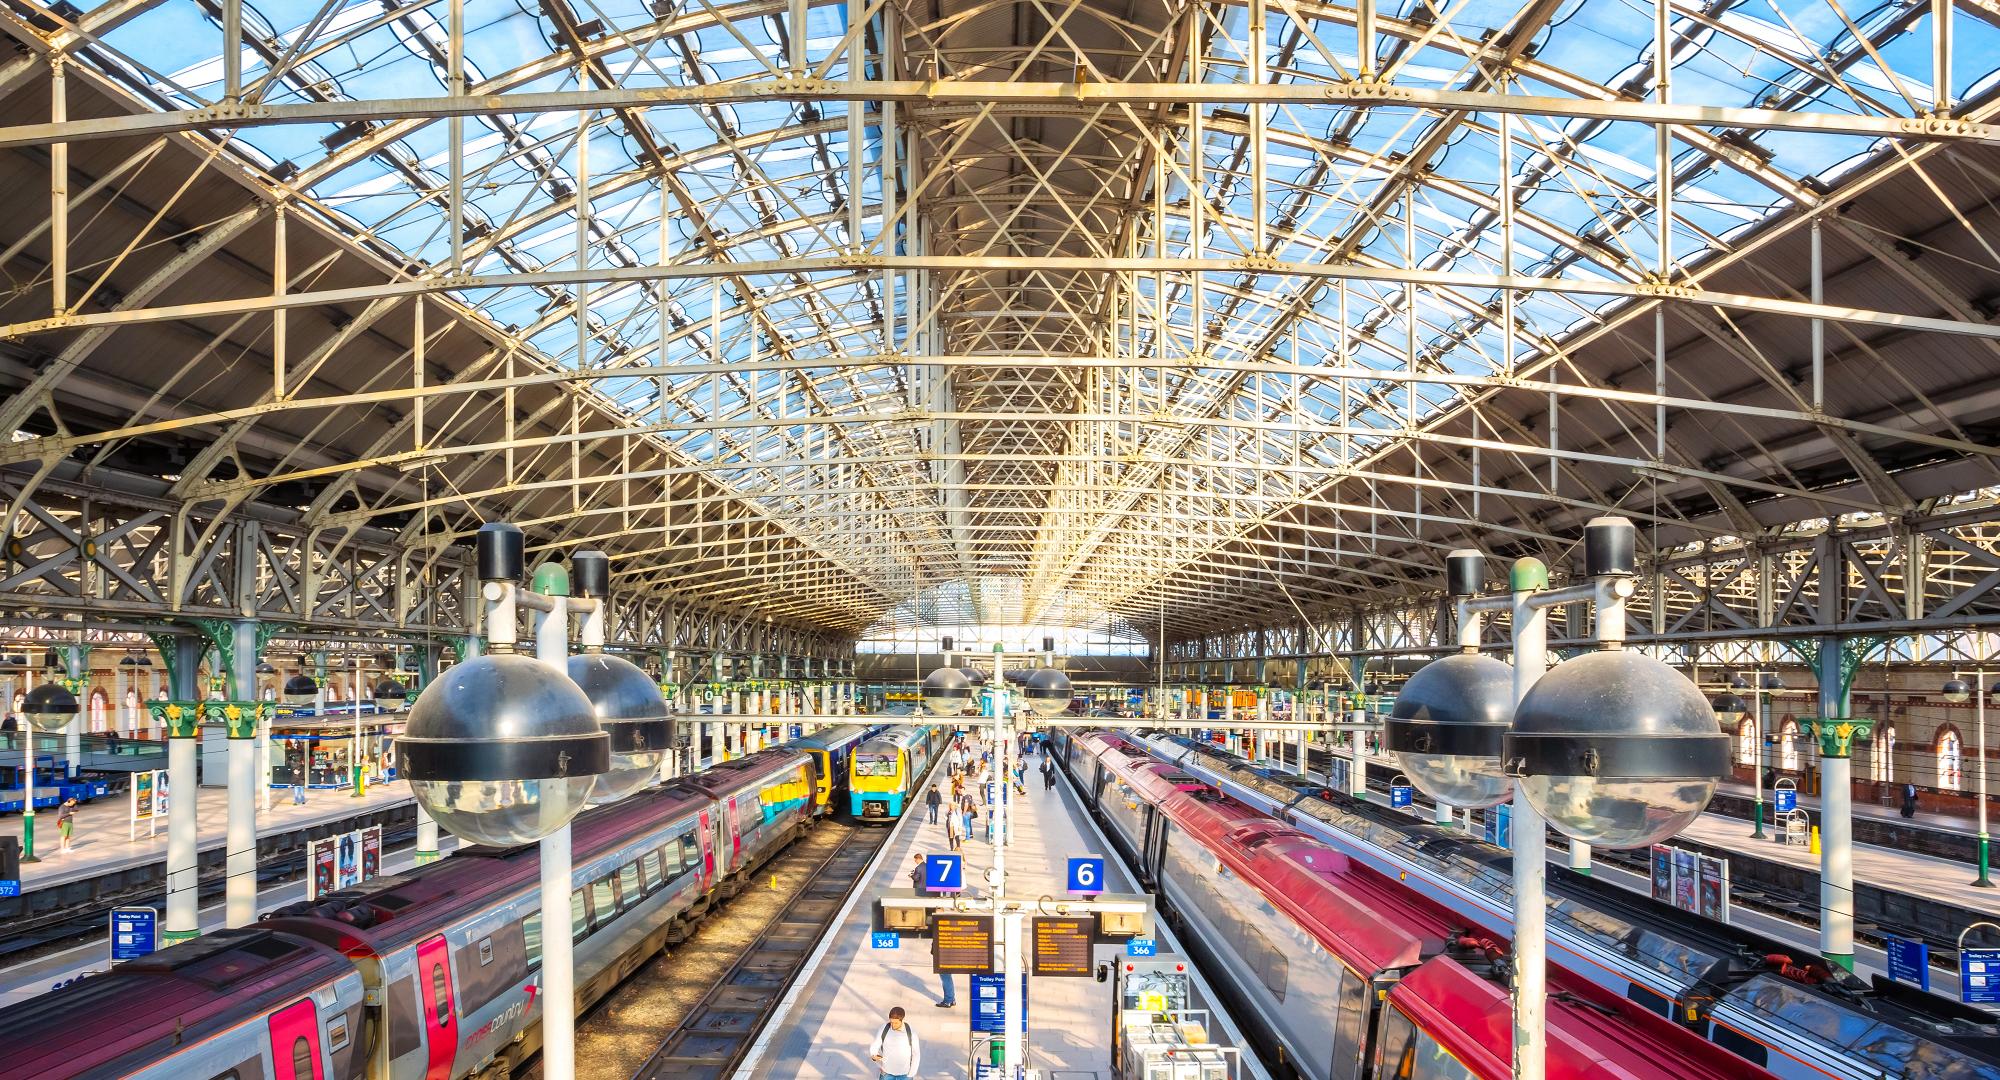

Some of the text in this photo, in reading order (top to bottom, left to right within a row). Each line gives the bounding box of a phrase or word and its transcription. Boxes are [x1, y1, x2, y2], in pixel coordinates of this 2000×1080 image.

[936, 860, 953, 882] 7
[1077, 863, 1095, 886] 6
[0, 886, 14, 895] 372
[877, 939, 894, 948] 368
[1133, 946, 1150, 955] 366
